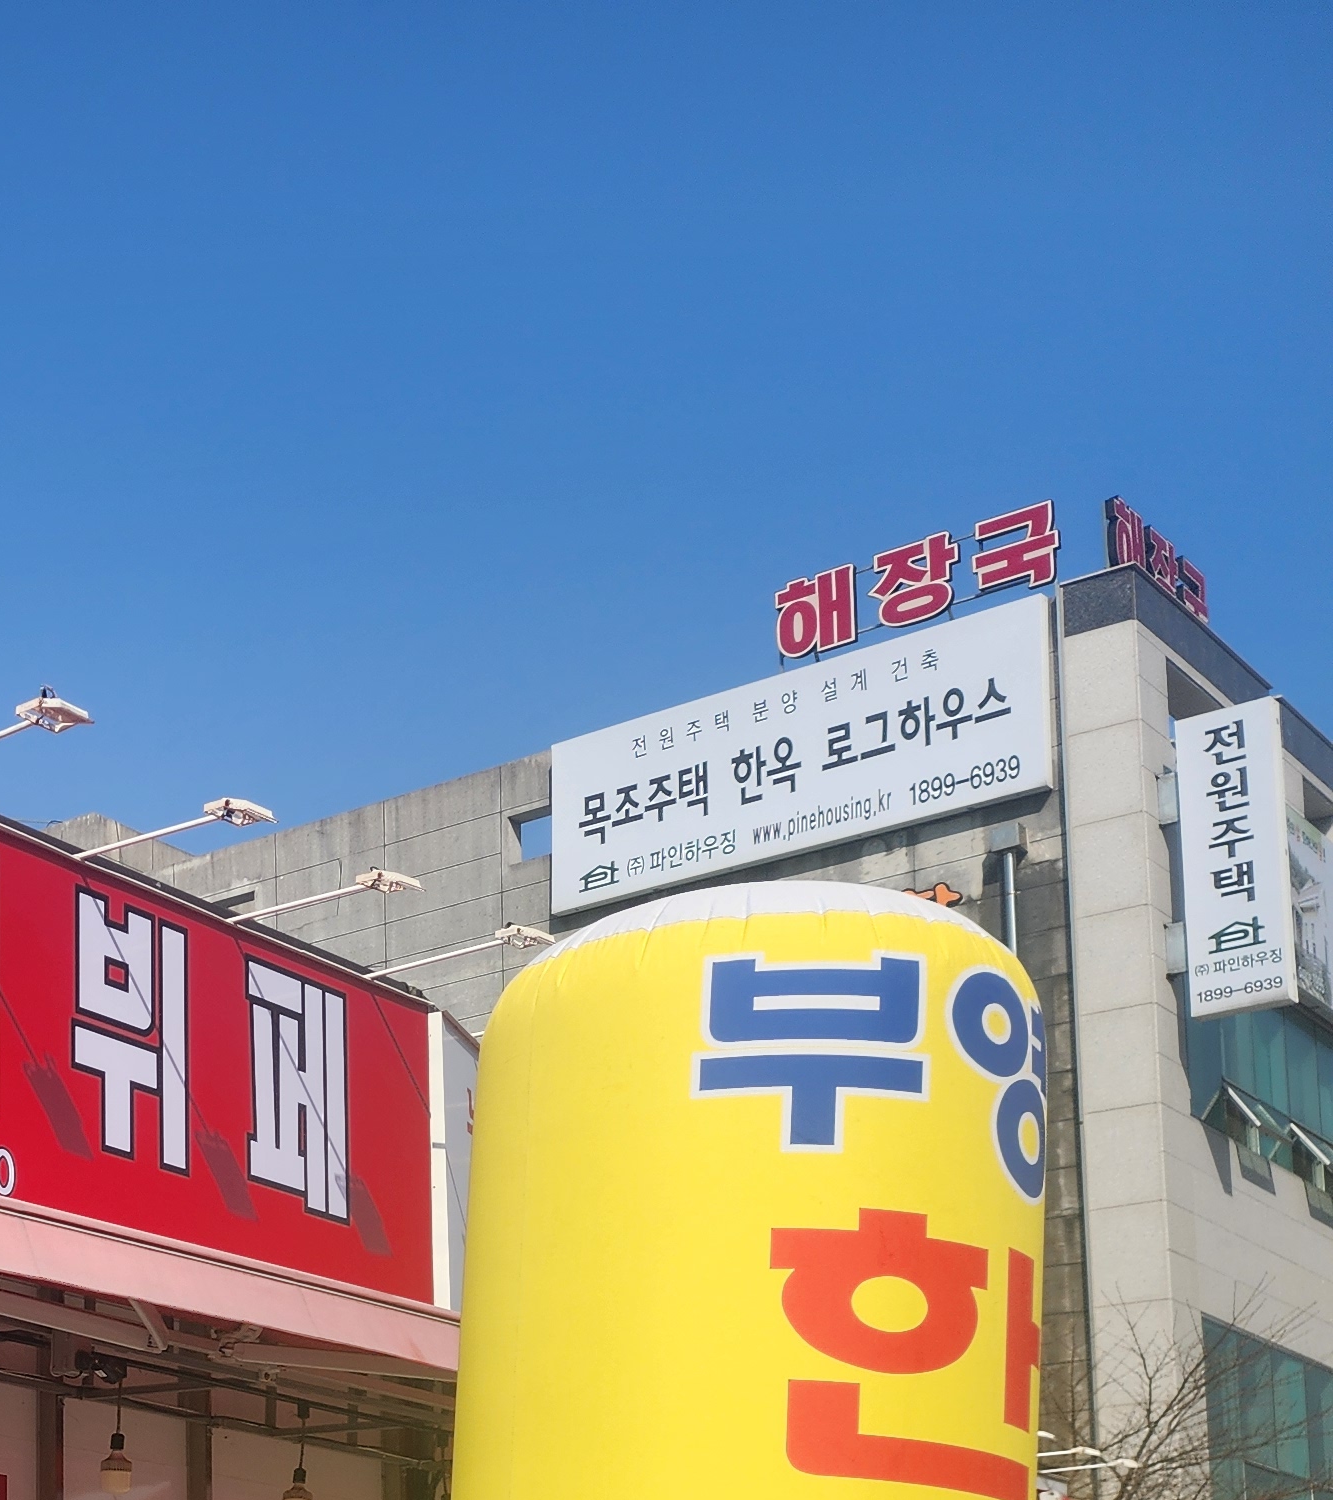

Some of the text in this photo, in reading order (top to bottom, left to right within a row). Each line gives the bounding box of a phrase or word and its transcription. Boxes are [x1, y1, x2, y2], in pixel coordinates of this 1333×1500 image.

[774, 499, 1061, 659] 해장국
[578, 677, 1011, 845] 목조주택 한옥 로그하우스
[632, 648, 939, 759] 전원주택 분양 설계 건축
[649, 829, 736, 872] 파인하우징
[752, 788, 892, 846] www.pinehousing.kr
[909, 754, 1021, 806] 1899-6939
[1203, 719, 1256, 903] 전원주택
[1196, 976, 1283, 1003] 1899-6939
[1213, 948, 1283, 974] 파인하우징
